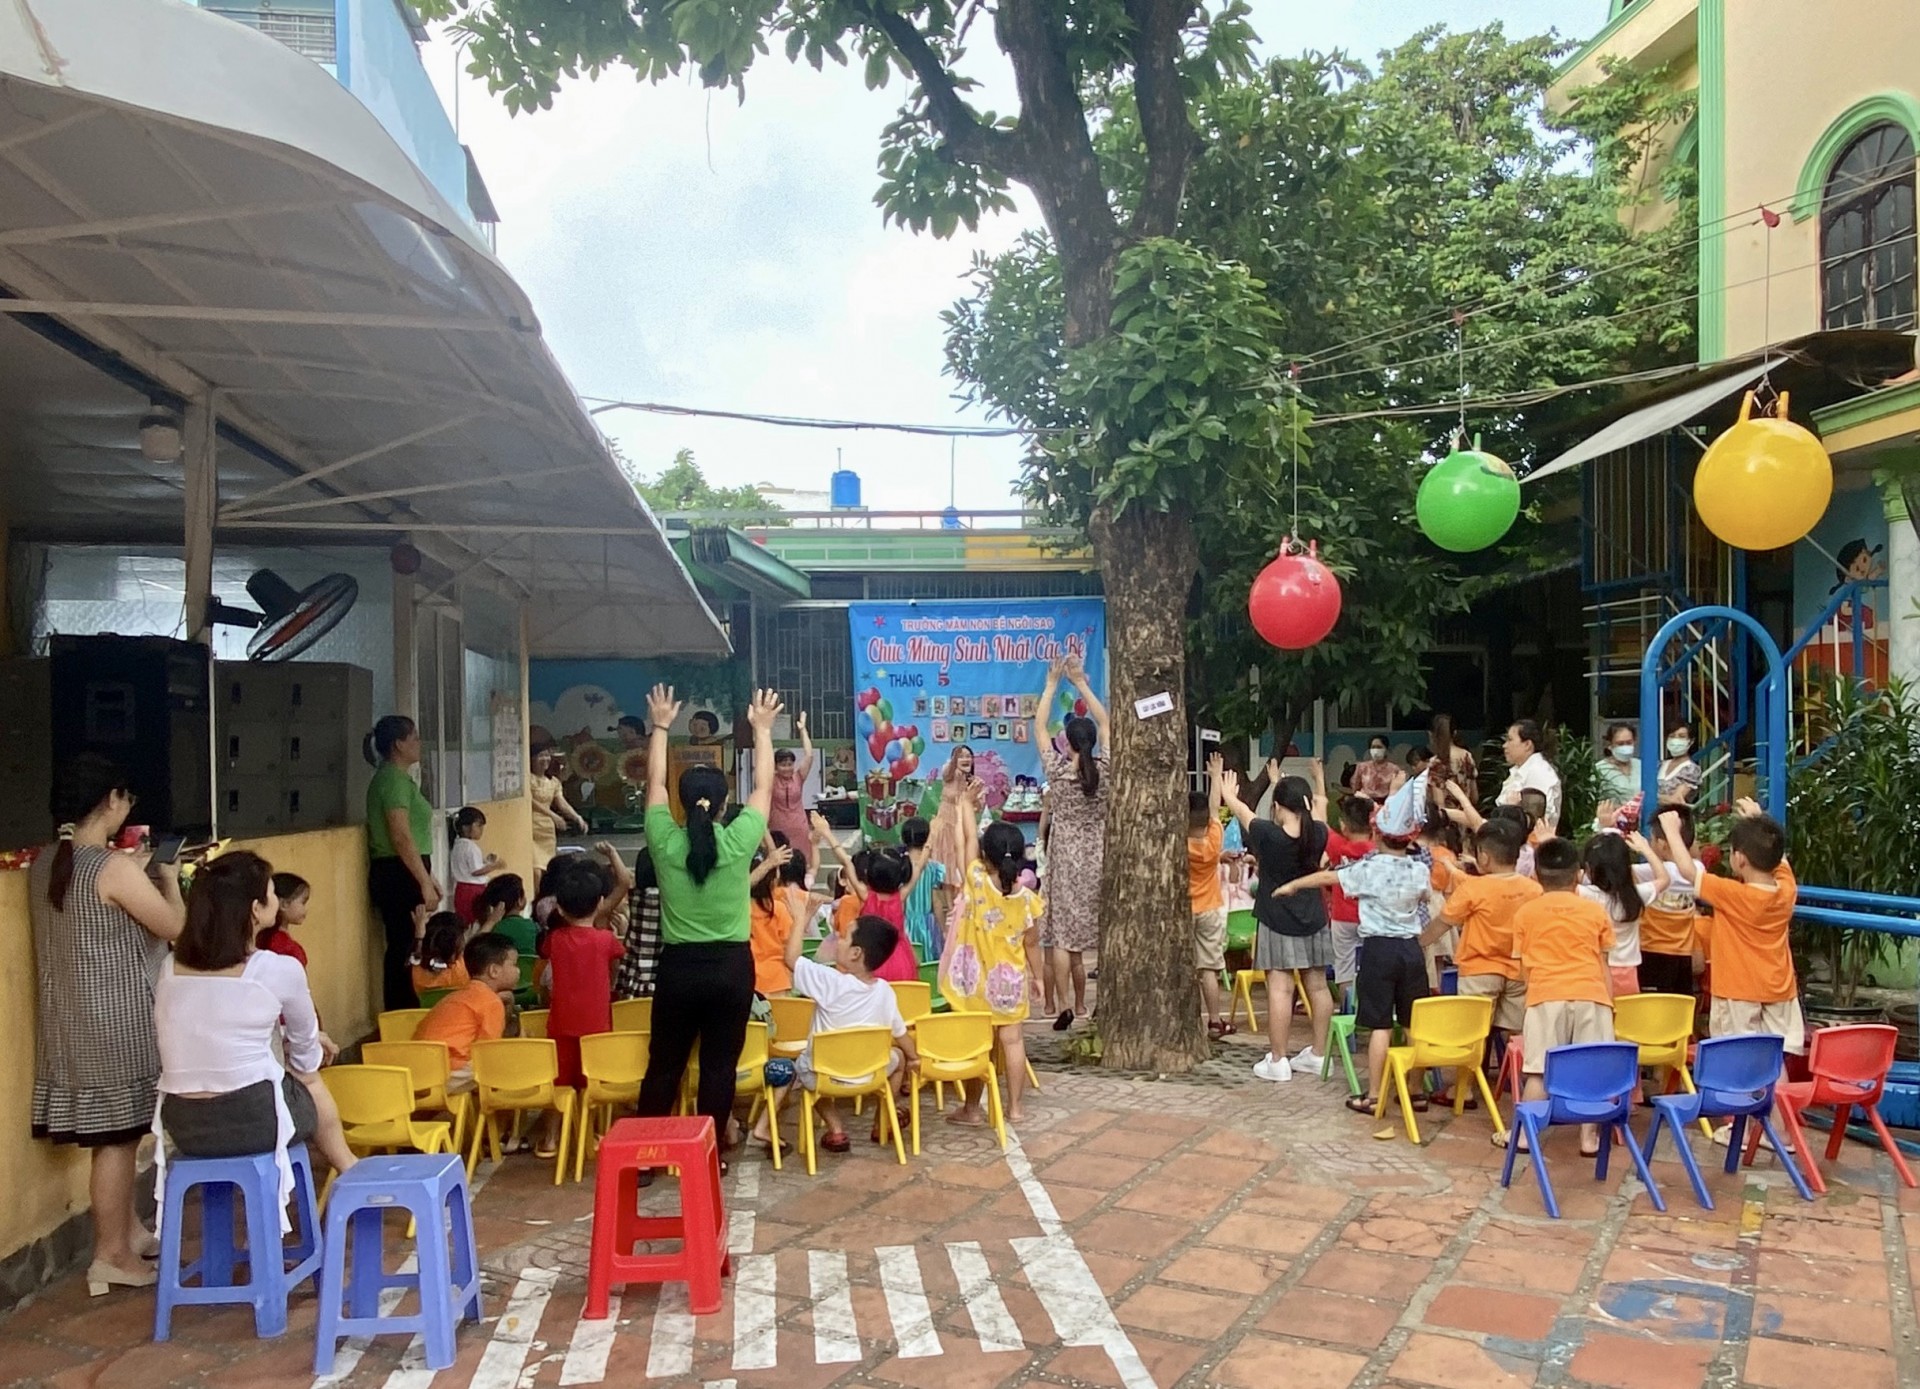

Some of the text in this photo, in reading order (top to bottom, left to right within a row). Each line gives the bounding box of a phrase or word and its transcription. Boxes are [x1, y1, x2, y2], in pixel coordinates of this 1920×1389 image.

[970, 617, 991, 631] NON
[1033, 616, 1055, 630] SAO
[868, 635, 905, 664] Chúc
[953, 635, 990, 663] Sinh
[993, 634, 1032, 668] Nhật
[1034, 633, 1062, 662] Các
[889, 671, 950, 687] THÁNG 5
